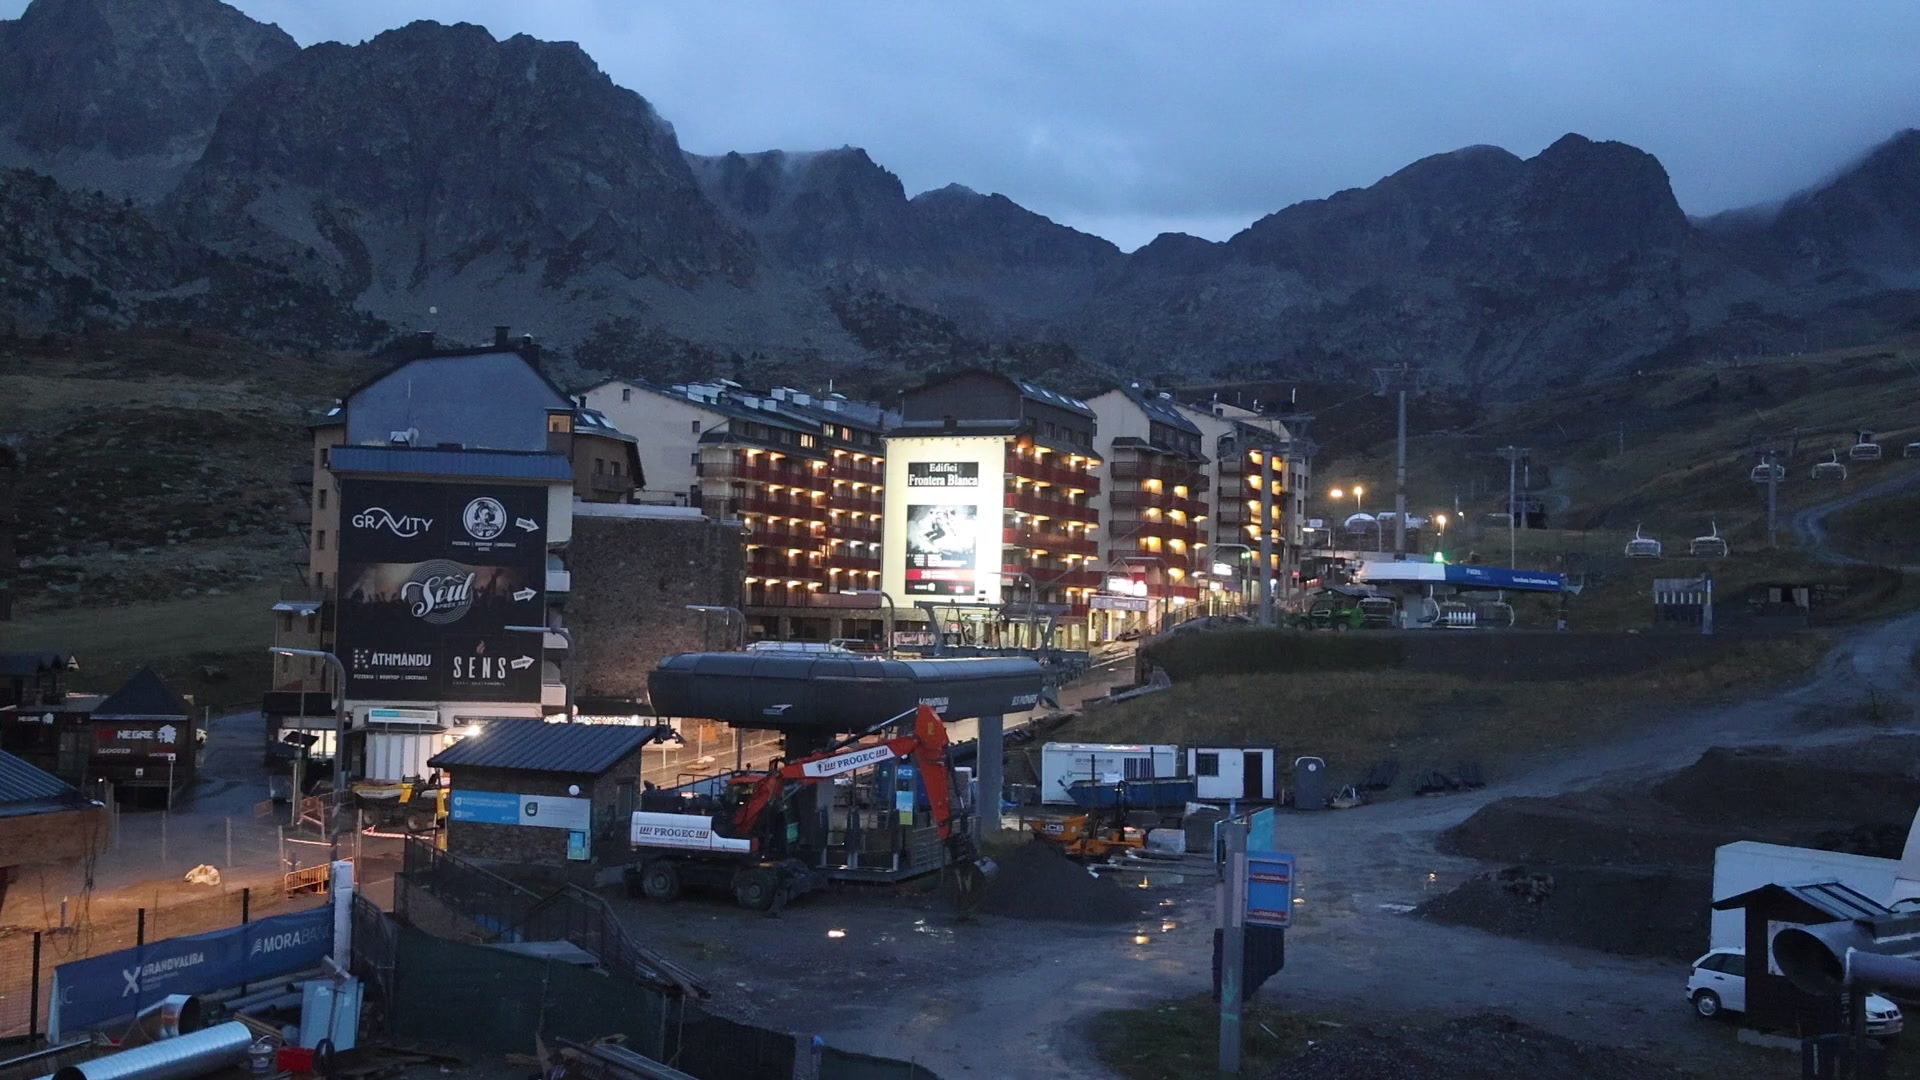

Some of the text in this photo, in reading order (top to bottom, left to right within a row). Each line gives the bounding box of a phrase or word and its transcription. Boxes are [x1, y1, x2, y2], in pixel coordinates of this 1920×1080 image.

[929, 463, 958, 473] Edifici
[908, 473, 978, 486] Frontera Blanca
[352, 508, 433, 536] GRAVITY
[401, 572, 476, 617] Soul
[453, 656, 507, 679] SENS
[117, 730, 154, 740] NEGRE
[838, 752, 876, 768] PROGEC
[898, 769, 913, 777] PC2
[654, 828, 696, 838] PROGEC
[1041, 824, 1065, 832] JCB
[142, 952, 204, 977] GRANDVALIRA
